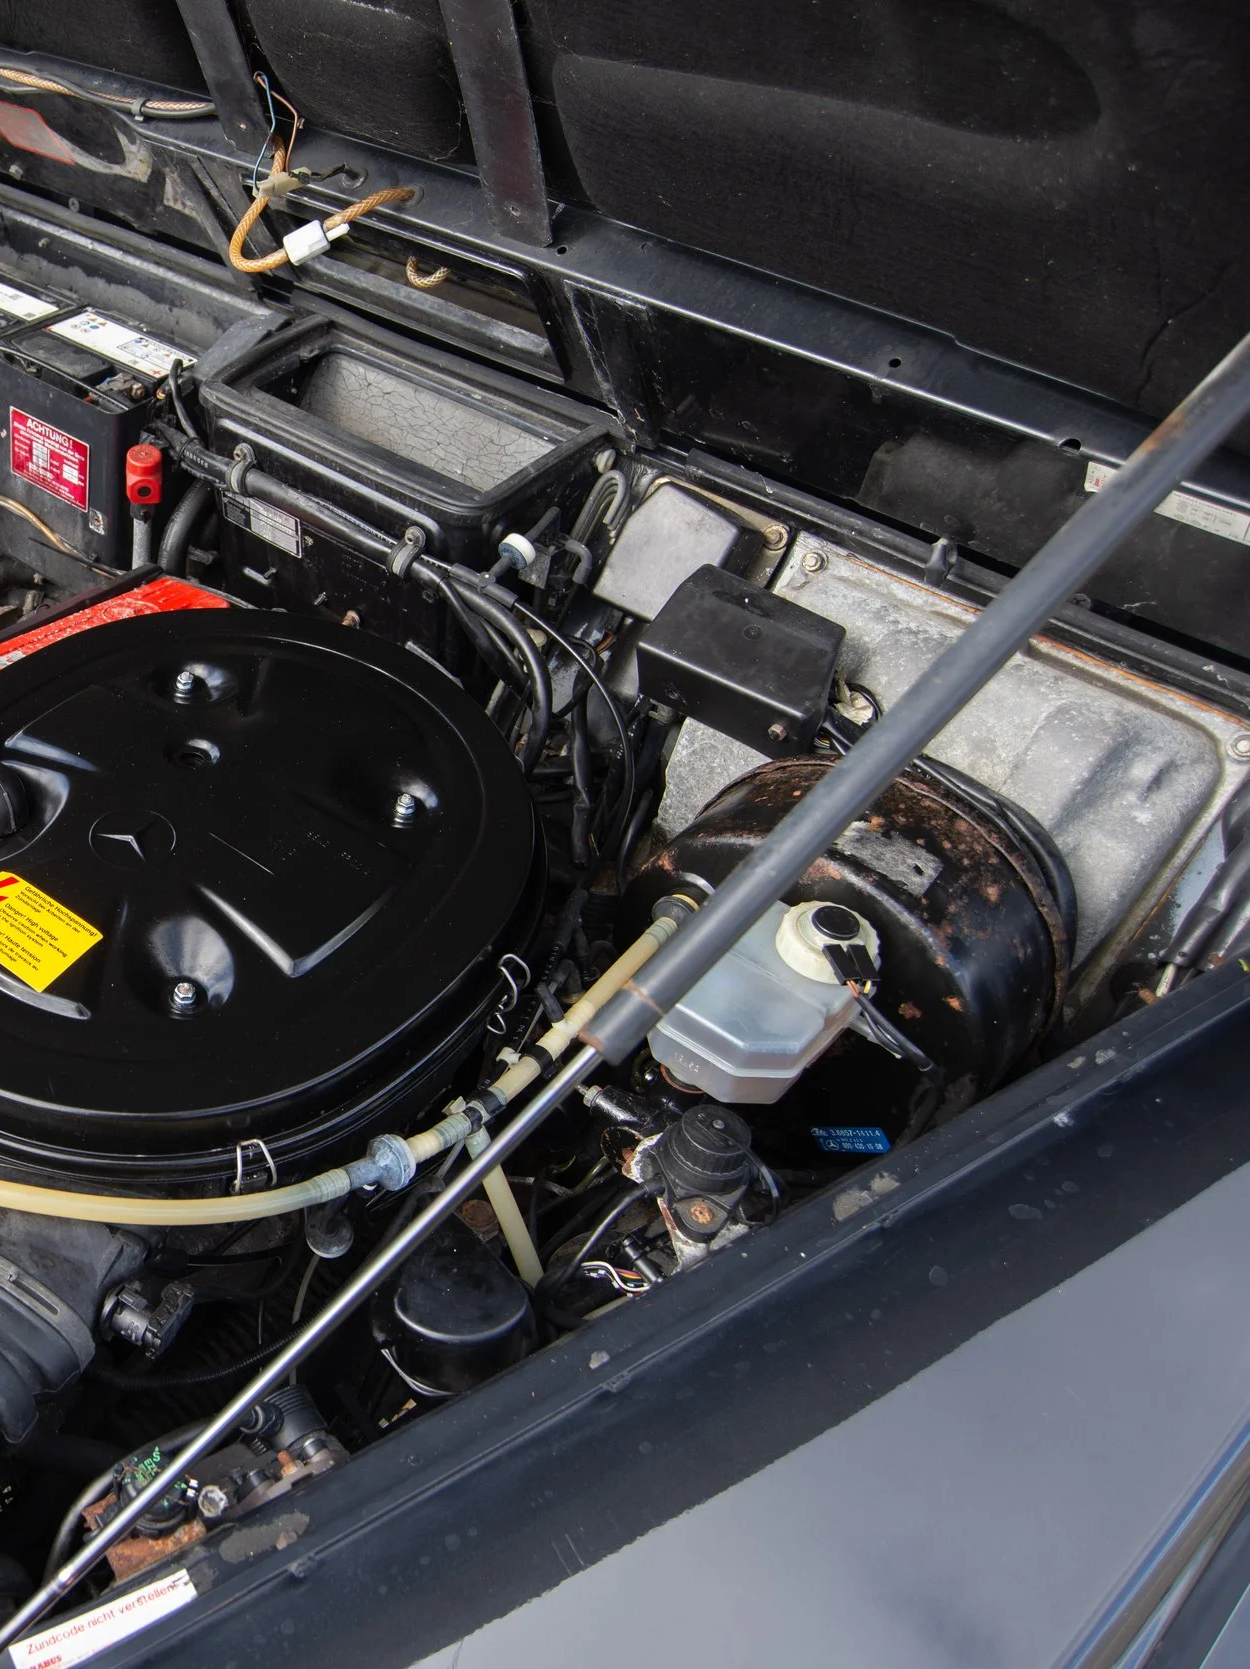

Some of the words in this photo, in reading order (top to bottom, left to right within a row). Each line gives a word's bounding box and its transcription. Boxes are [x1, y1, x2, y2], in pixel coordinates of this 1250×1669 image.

[5, 902, 26, 918] Danger!
[26, 917, 39, 928] High
[39, 926, 58, 941] voltage
[25, 886, 54, 907] Gefährliche
[55, 905, 97, 937] Hochspannung!
[46, 909, 65, 923] Arbeiten
[0, 908, 18, 922] Observe
[18, 921, 36, 934] caution
[36, 933, 48, 943] when
[49, 942, 68, 958] working
[9, 921, 26, 935] ignition
[27, 934, 44, 947] system
[5, 935, 21, 948] Haute
[20, 946, 41, 963] tension
[87, 1609, 116, 1629] nicht
